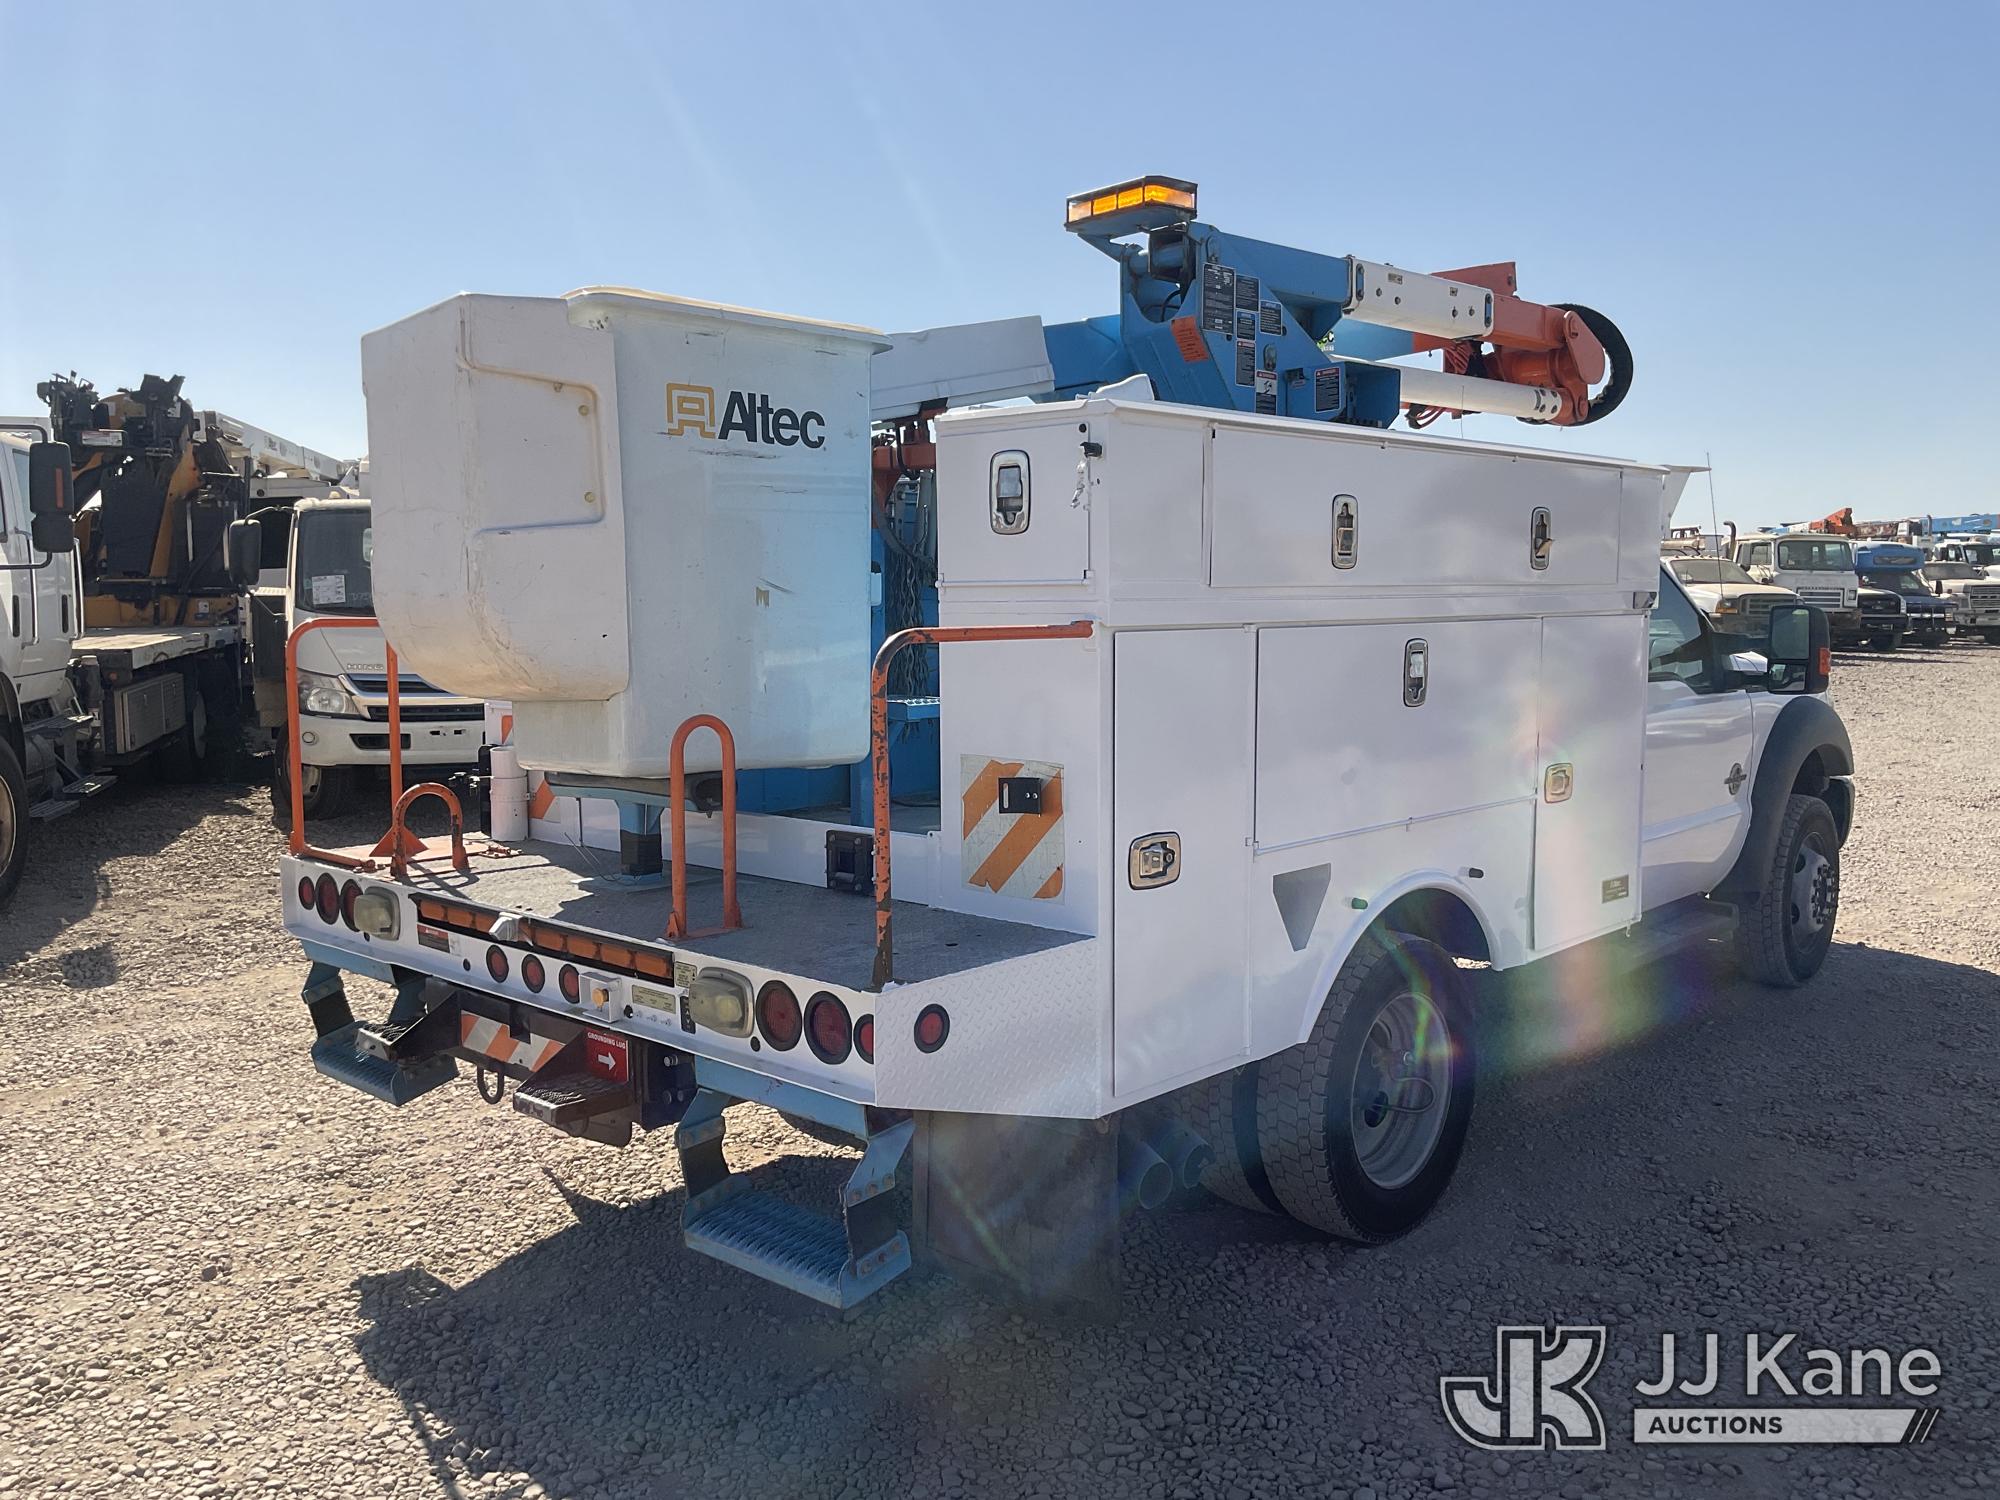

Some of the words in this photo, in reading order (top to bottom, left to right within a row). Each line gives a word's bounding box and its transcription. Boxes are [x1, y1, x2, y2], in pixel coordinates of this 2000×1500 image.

[718, 390, 825, 449] Altec
[587, 1031, 615, 1046] GROUNDING
[615, 1040, 626, 1049] LUG
